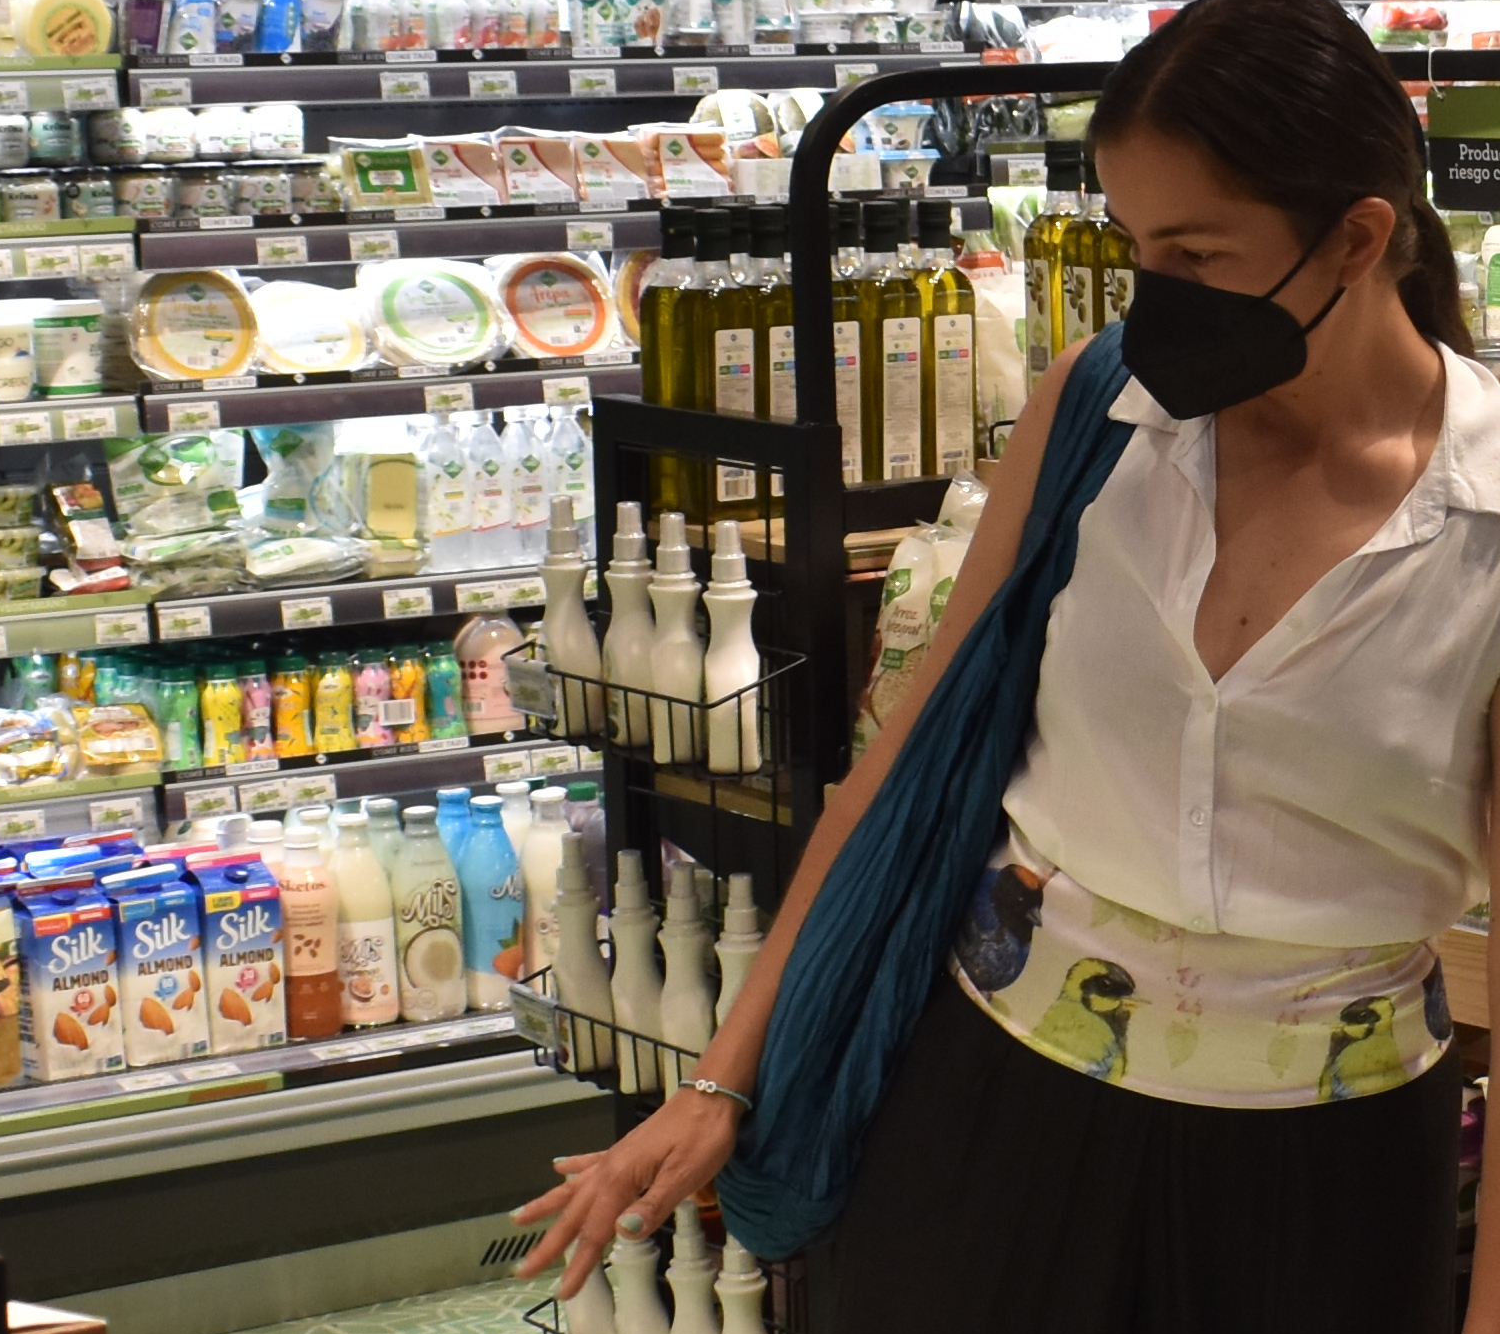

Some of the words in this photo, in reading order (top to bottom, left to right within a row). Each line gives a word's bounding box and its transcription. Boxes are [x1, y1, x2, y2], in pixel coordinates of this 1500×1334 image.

[1448, 164, 1490, 185] riesgo
[132, 910, 189, 959] Silk
[216, 905, 275, 950] Silk
[47, 926, 106, 973] Silk
[219, 947, 275, 968] ALMOND
[137, 955, 194, 976] ALMOND
[52, 970, 110, 992] ALMOND
